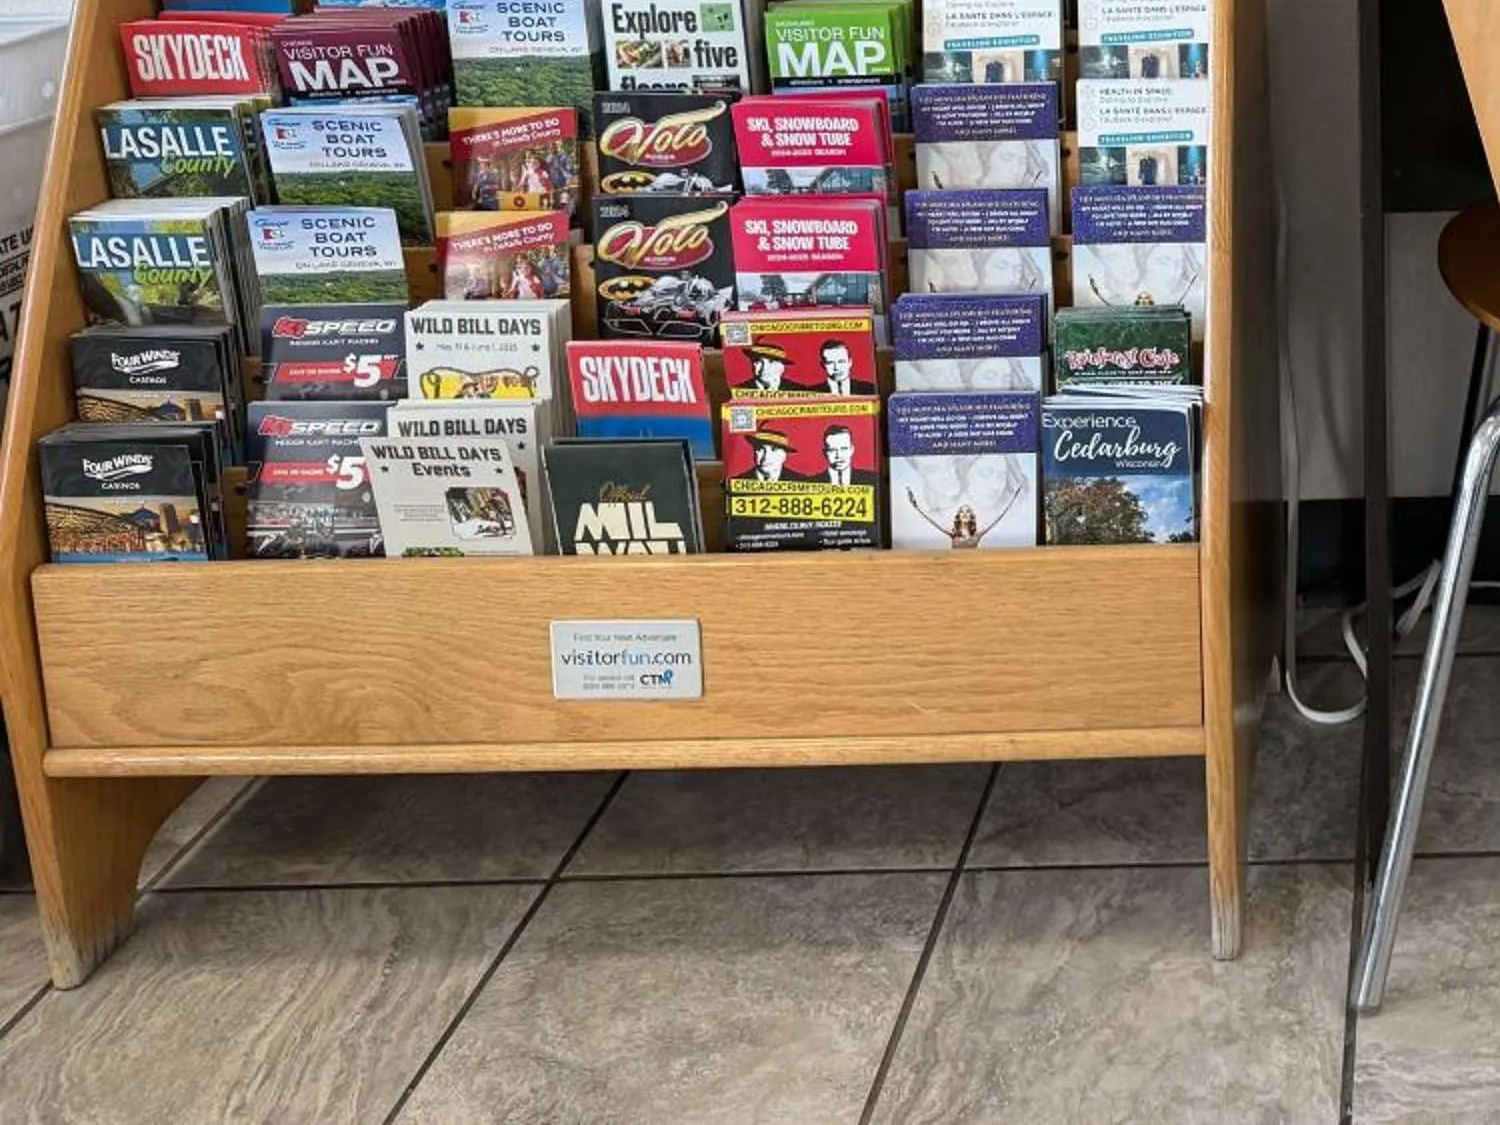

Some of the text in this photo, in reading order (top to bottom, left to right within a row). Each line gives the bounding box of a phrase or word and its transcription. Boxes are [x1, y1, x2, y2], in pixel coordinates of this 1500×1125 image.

[496, 3, 565, 14] SCENIC
[508, 16, 557, 28] BOAT
[611, 3, 697, 38] Explore
[502, 30, 566, 42] TOURS
[776, 27, 884, 41] VISITOR FUN
[133, 34, 249, 80] SKYDECK
[283, 43, 393, 60] VISITOR FUN
[694, 38, 738, 68] five
[778, 42, 886, 76] MAP
[289, 58, 399, 91] MAP
[312, 120, 382, 132] SCENIC
[529, 121, 543, 130] TO
[544, 117, 559, 128] DO
[748, 118, 859, 132] SKI, SNOWBOARD
[326, 134, 375, 146] BOAT
[600, 100, 726, 165] Volo
[761, 132, 852, 147] & SNOW TUBE
[101, 127, 233, 159] LASALLE
[321, 147, 388, 158] TOURS
[161, 154, 237, 177] County
[301, 217, 374, 230] SCENIC
[522, 226, 537, 236] TO
[538, 222, 553, 233] DO
[745, 220, 858, 235] SKI, SNOWBOARD
[315, 232, 366, 244] BOAT
[598, 201, 728, 269] Volo
[309, 245, 377, 258] TOURS
[758, 236, 850, 251] & SNOW TUBE
[72, 236, 210, 268] LASALLE
[133, 263, 214, 284] County
[304, 319, 396, 334] SPEED
[411, 318, 541, 335] WILD BILL DAYS
[111, 350, 180, 371] FOUR WINDS
[344, 353, 383, 388] $5
[579, 357, 696, 403] SKYDECK
[291, 420, 378, 435] SPEED
[399, 419, 526, 436] WILD BILL DAYS
[1043, 413, 1137, 431] Experience
[372, 445, 501, 461] WILD BILL DAYS
[1054, 427, 1181, 468] Cedarburg
[83, 454, 154, 476] FOUR WINDS
[326, 453, 365, 490] $5
[413, 463, 470, 477] Events
[102, 482, 140, 490] CASINOS
[736, 497, 867, 517] 312-888-6224
[575, 503, 682, 540] MIL
[562, 649, 691, 665] visitorfun.com
[640, 673, 672, 686] CTM
